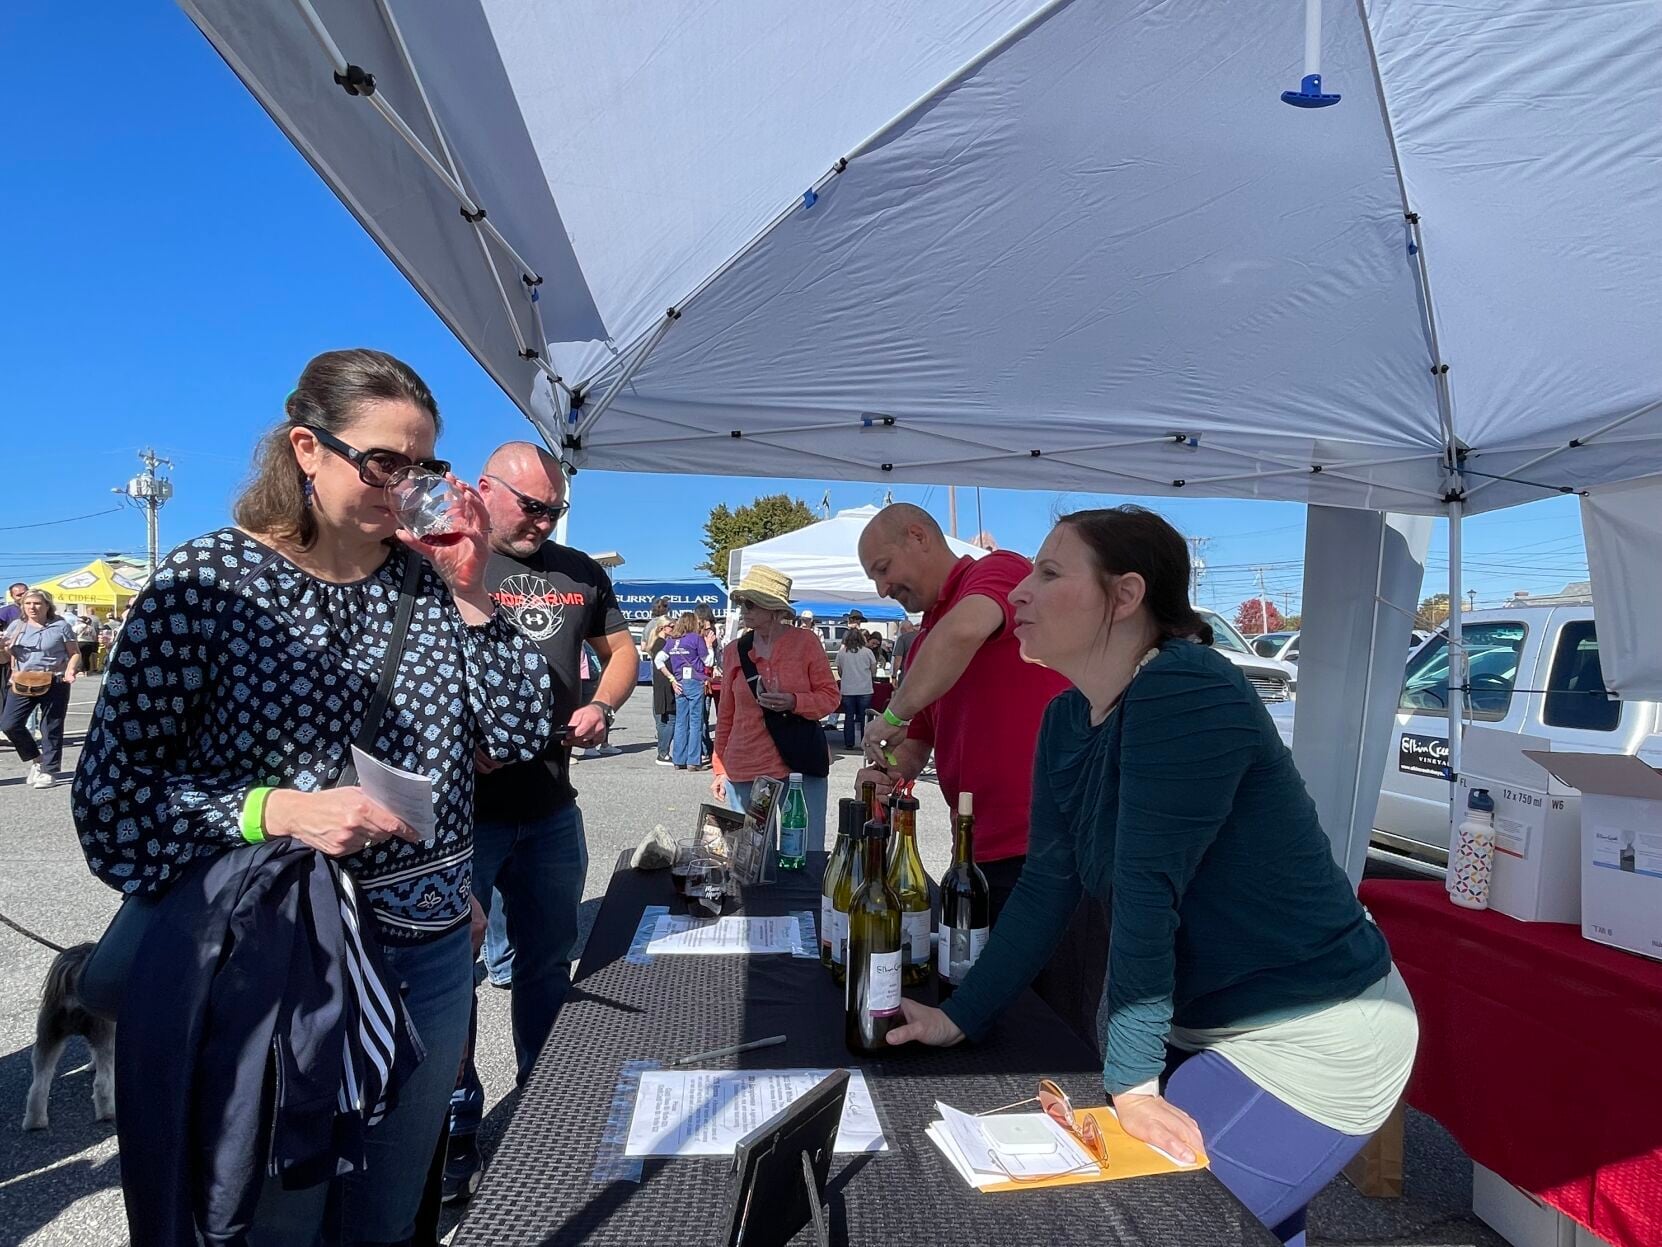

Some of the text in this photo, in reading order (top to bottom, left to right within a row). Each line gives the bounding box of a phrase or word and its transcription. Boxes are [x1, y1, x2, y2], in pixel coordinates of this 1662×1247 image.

[68, 594, 97, 603] CIDER
[615, 594, 719, 604] SURRY CELLARS
[1402, 737, 1449, 758] Elkin Cree
[1460, 777, 1468, 788] FL
[1503, 788, 1511, 800] 12
[1518, 792, 1532, 805] 750
[1533, 796, 1543, 808] ml
[1552, 799, 1564, 810] W6
